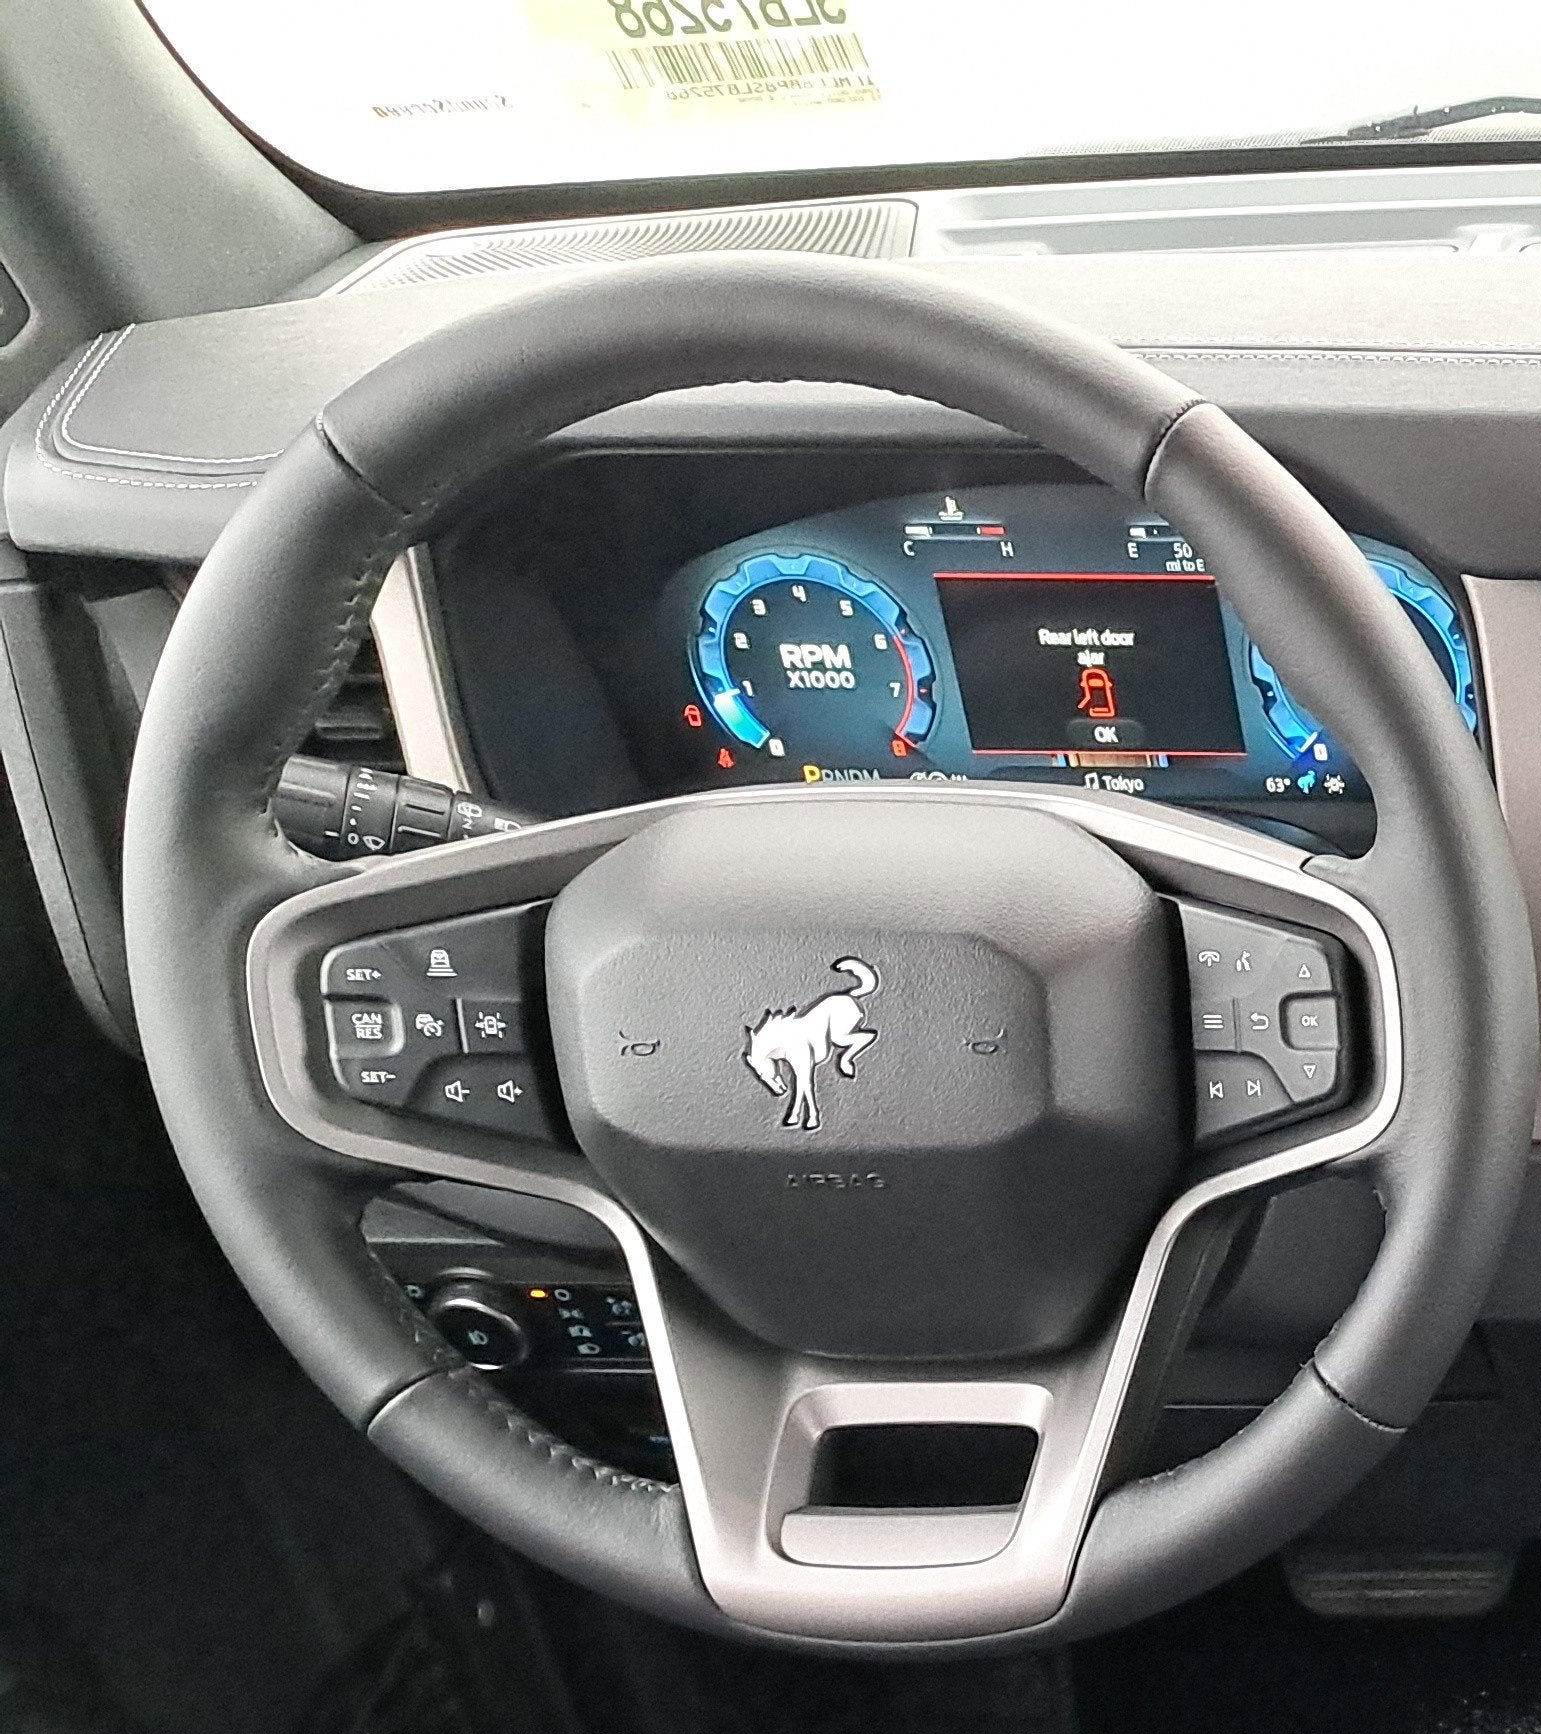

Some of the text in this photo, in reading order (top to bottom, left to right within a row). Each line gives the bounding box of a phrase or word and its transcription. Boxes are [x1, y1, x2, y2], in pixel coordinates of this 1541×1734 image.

[903, 541, 916, 557] C
[1001, 542, 1014, 558] H
[1128, 543, 1139, 558] E
[1173, 543, 1193, 558] 50
[792, 586, 806, 603] 4
[752, 599, 767, 616] 3
[840, 600, 855, 617] 5
[734, 633, 749, 649] 2
[874, 634, 888, 650] 6
[1038, 628, 1134, 647] Rear left door
[780, 643, 852, 670] RPM
[788, 671, 855, 689] X1000
[743, 681, 754, 697] 1
[890, 683, 901, 698] 7
[1095, 727, 1118, 743] OK
[892, 740, 907, 756] 8
[1101, 774, 1144, 793] Tokyo
[352, 1013, 382, 1025] CAN
[1301, 1015, 1319, 1027] OK
[355, 1027, 383, 1040] RES
